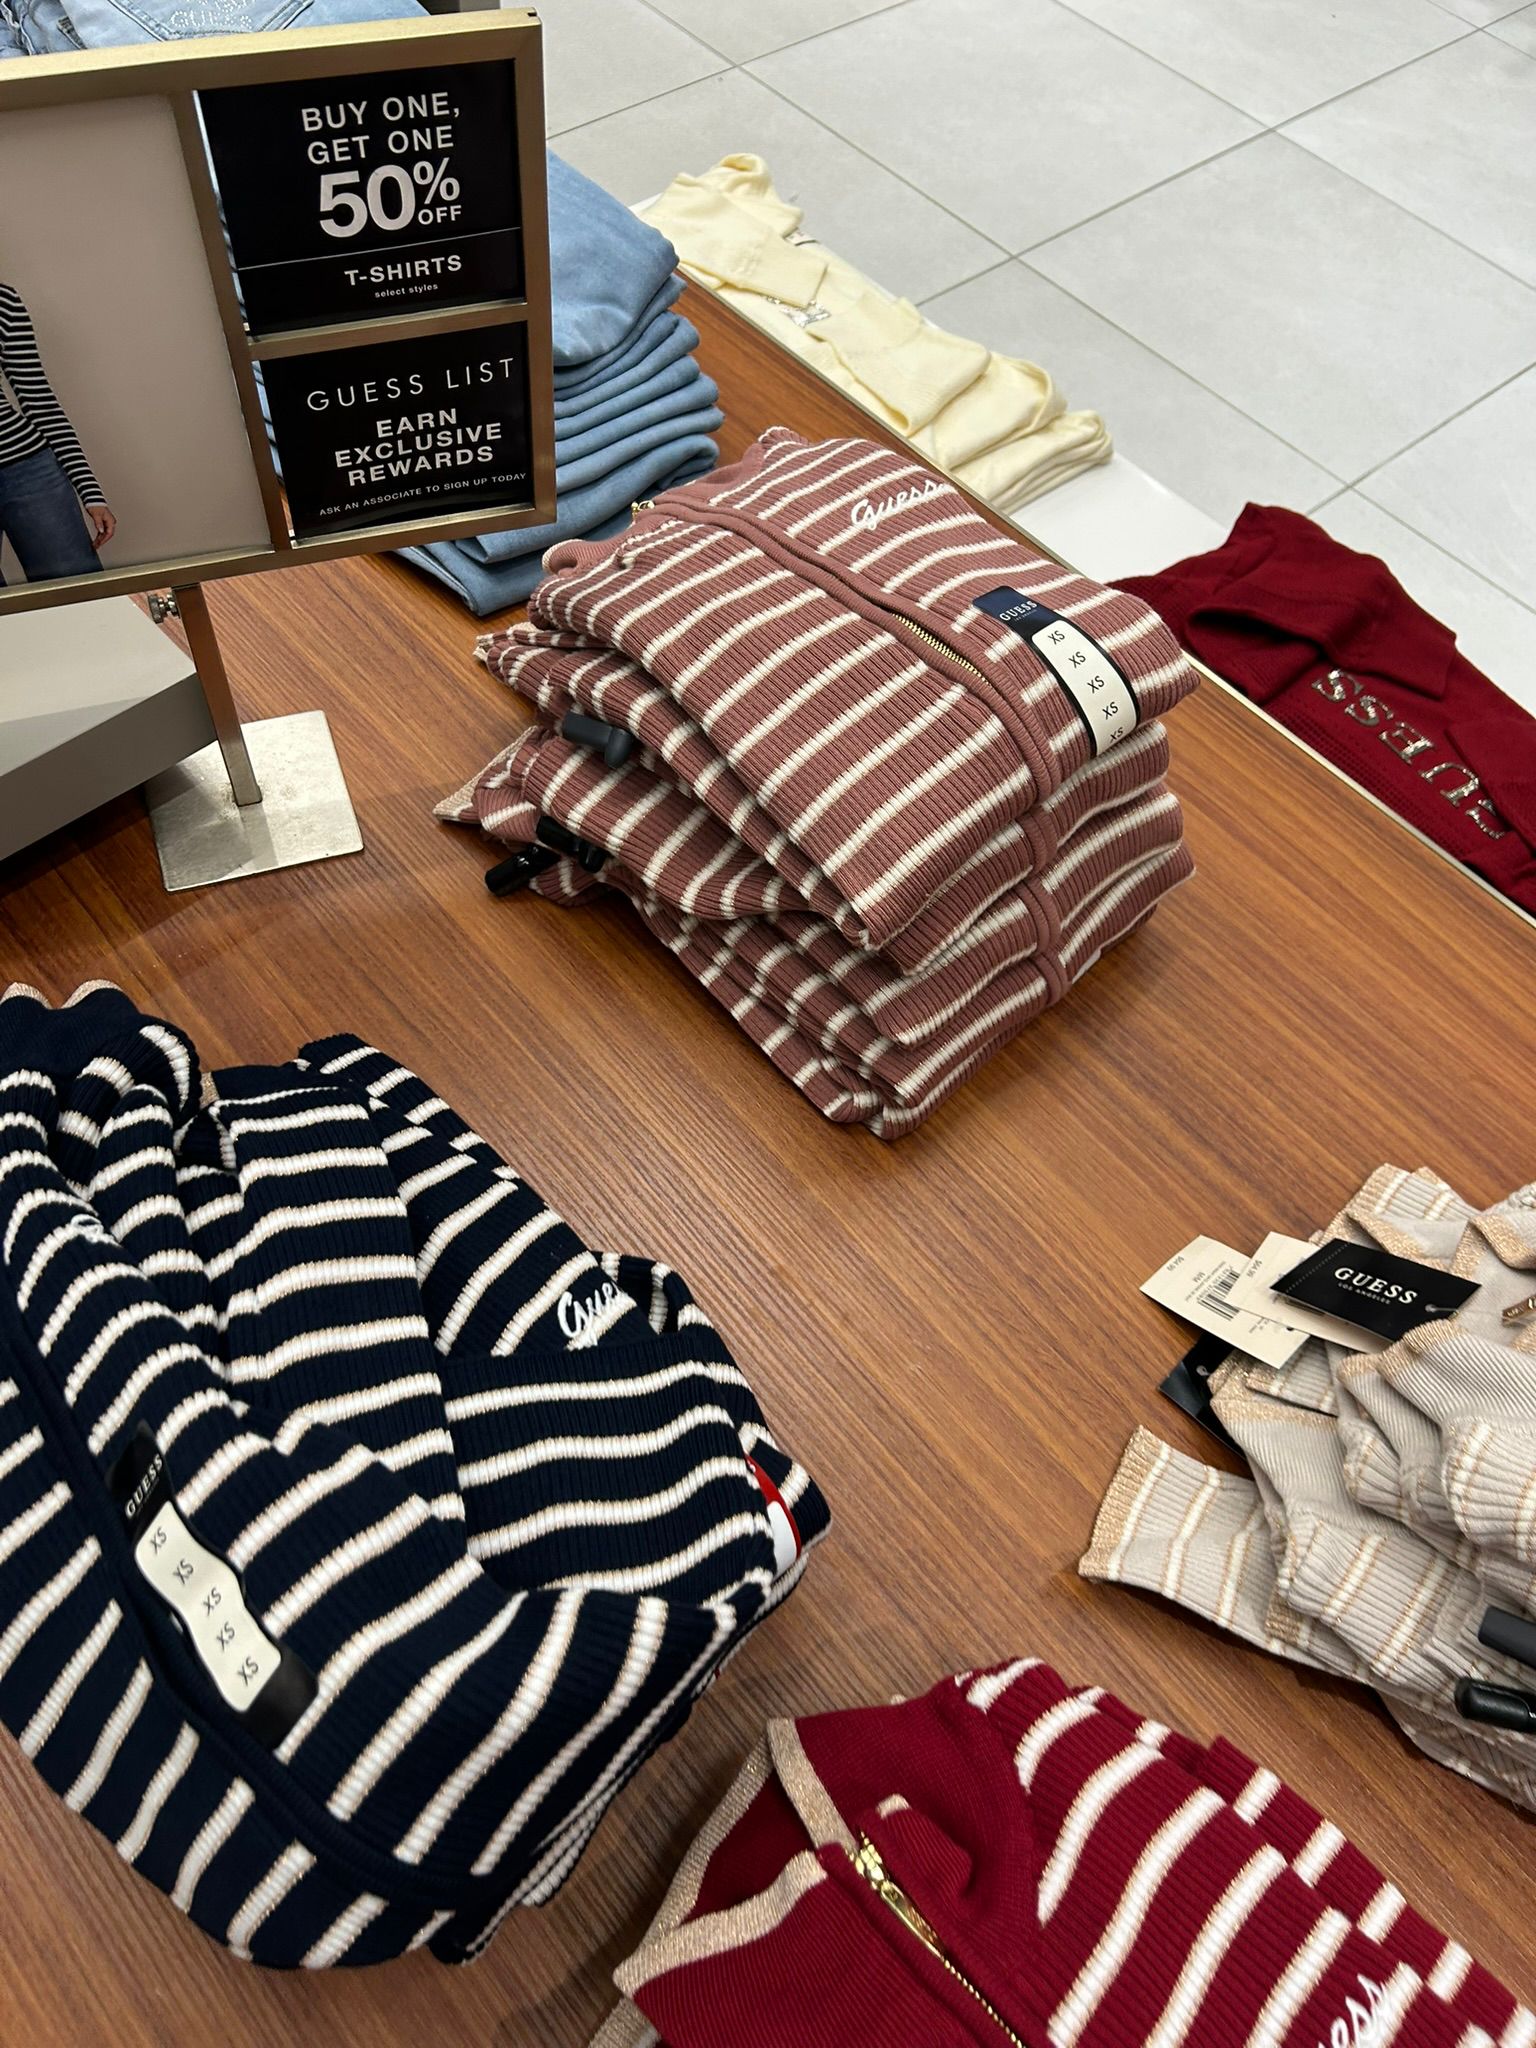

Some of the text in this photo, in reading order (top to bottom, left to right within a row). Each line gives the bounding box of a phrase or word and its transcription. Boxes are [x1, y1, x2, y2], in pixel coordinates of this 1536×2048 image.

[301, 92, 460, 132] BUY ONE,
[307, 125, 455, 165] GET ONE
[319, 157, 460, 238] 50%
[418, 205, 462, 225] OFF
[344, 255, 462, 286] T-SHIRTS
[374, 283, 439, 298] select styles
[306, 358, 514, 411] GUESS LIST
[376, 408, 458, 438] EARN
[335, 423, 502, 468] EXCLUSIVE
[348, 446, 493, 487] REWARDS
[319, 473, 527, 516] ASK AN ASSOCIATE TO SIGN UP TODAY
[851, 480, 947, 530] Guess
[999, 600, 1037, 621] GUESS
[1047, 629, 1066, 646] XS
[1068, 651, 1087, 669] XS
[1087, 675, 1106, 693] XS
[1102, 701, 1119, 720] XS
[1109, 726, 1124, 742] XS
[1334, 1267, 1418, 1304] GUESS
[125, 1453, 163, 1519] GUESS
[149, 1526, 168, 1554] XS
[173, 1558, 194, 1586] XS
[202, 1587, 222, 1616] XS
[216, 1621, 235, 1650] XS
[236, 1656, 259, 1686] XS
